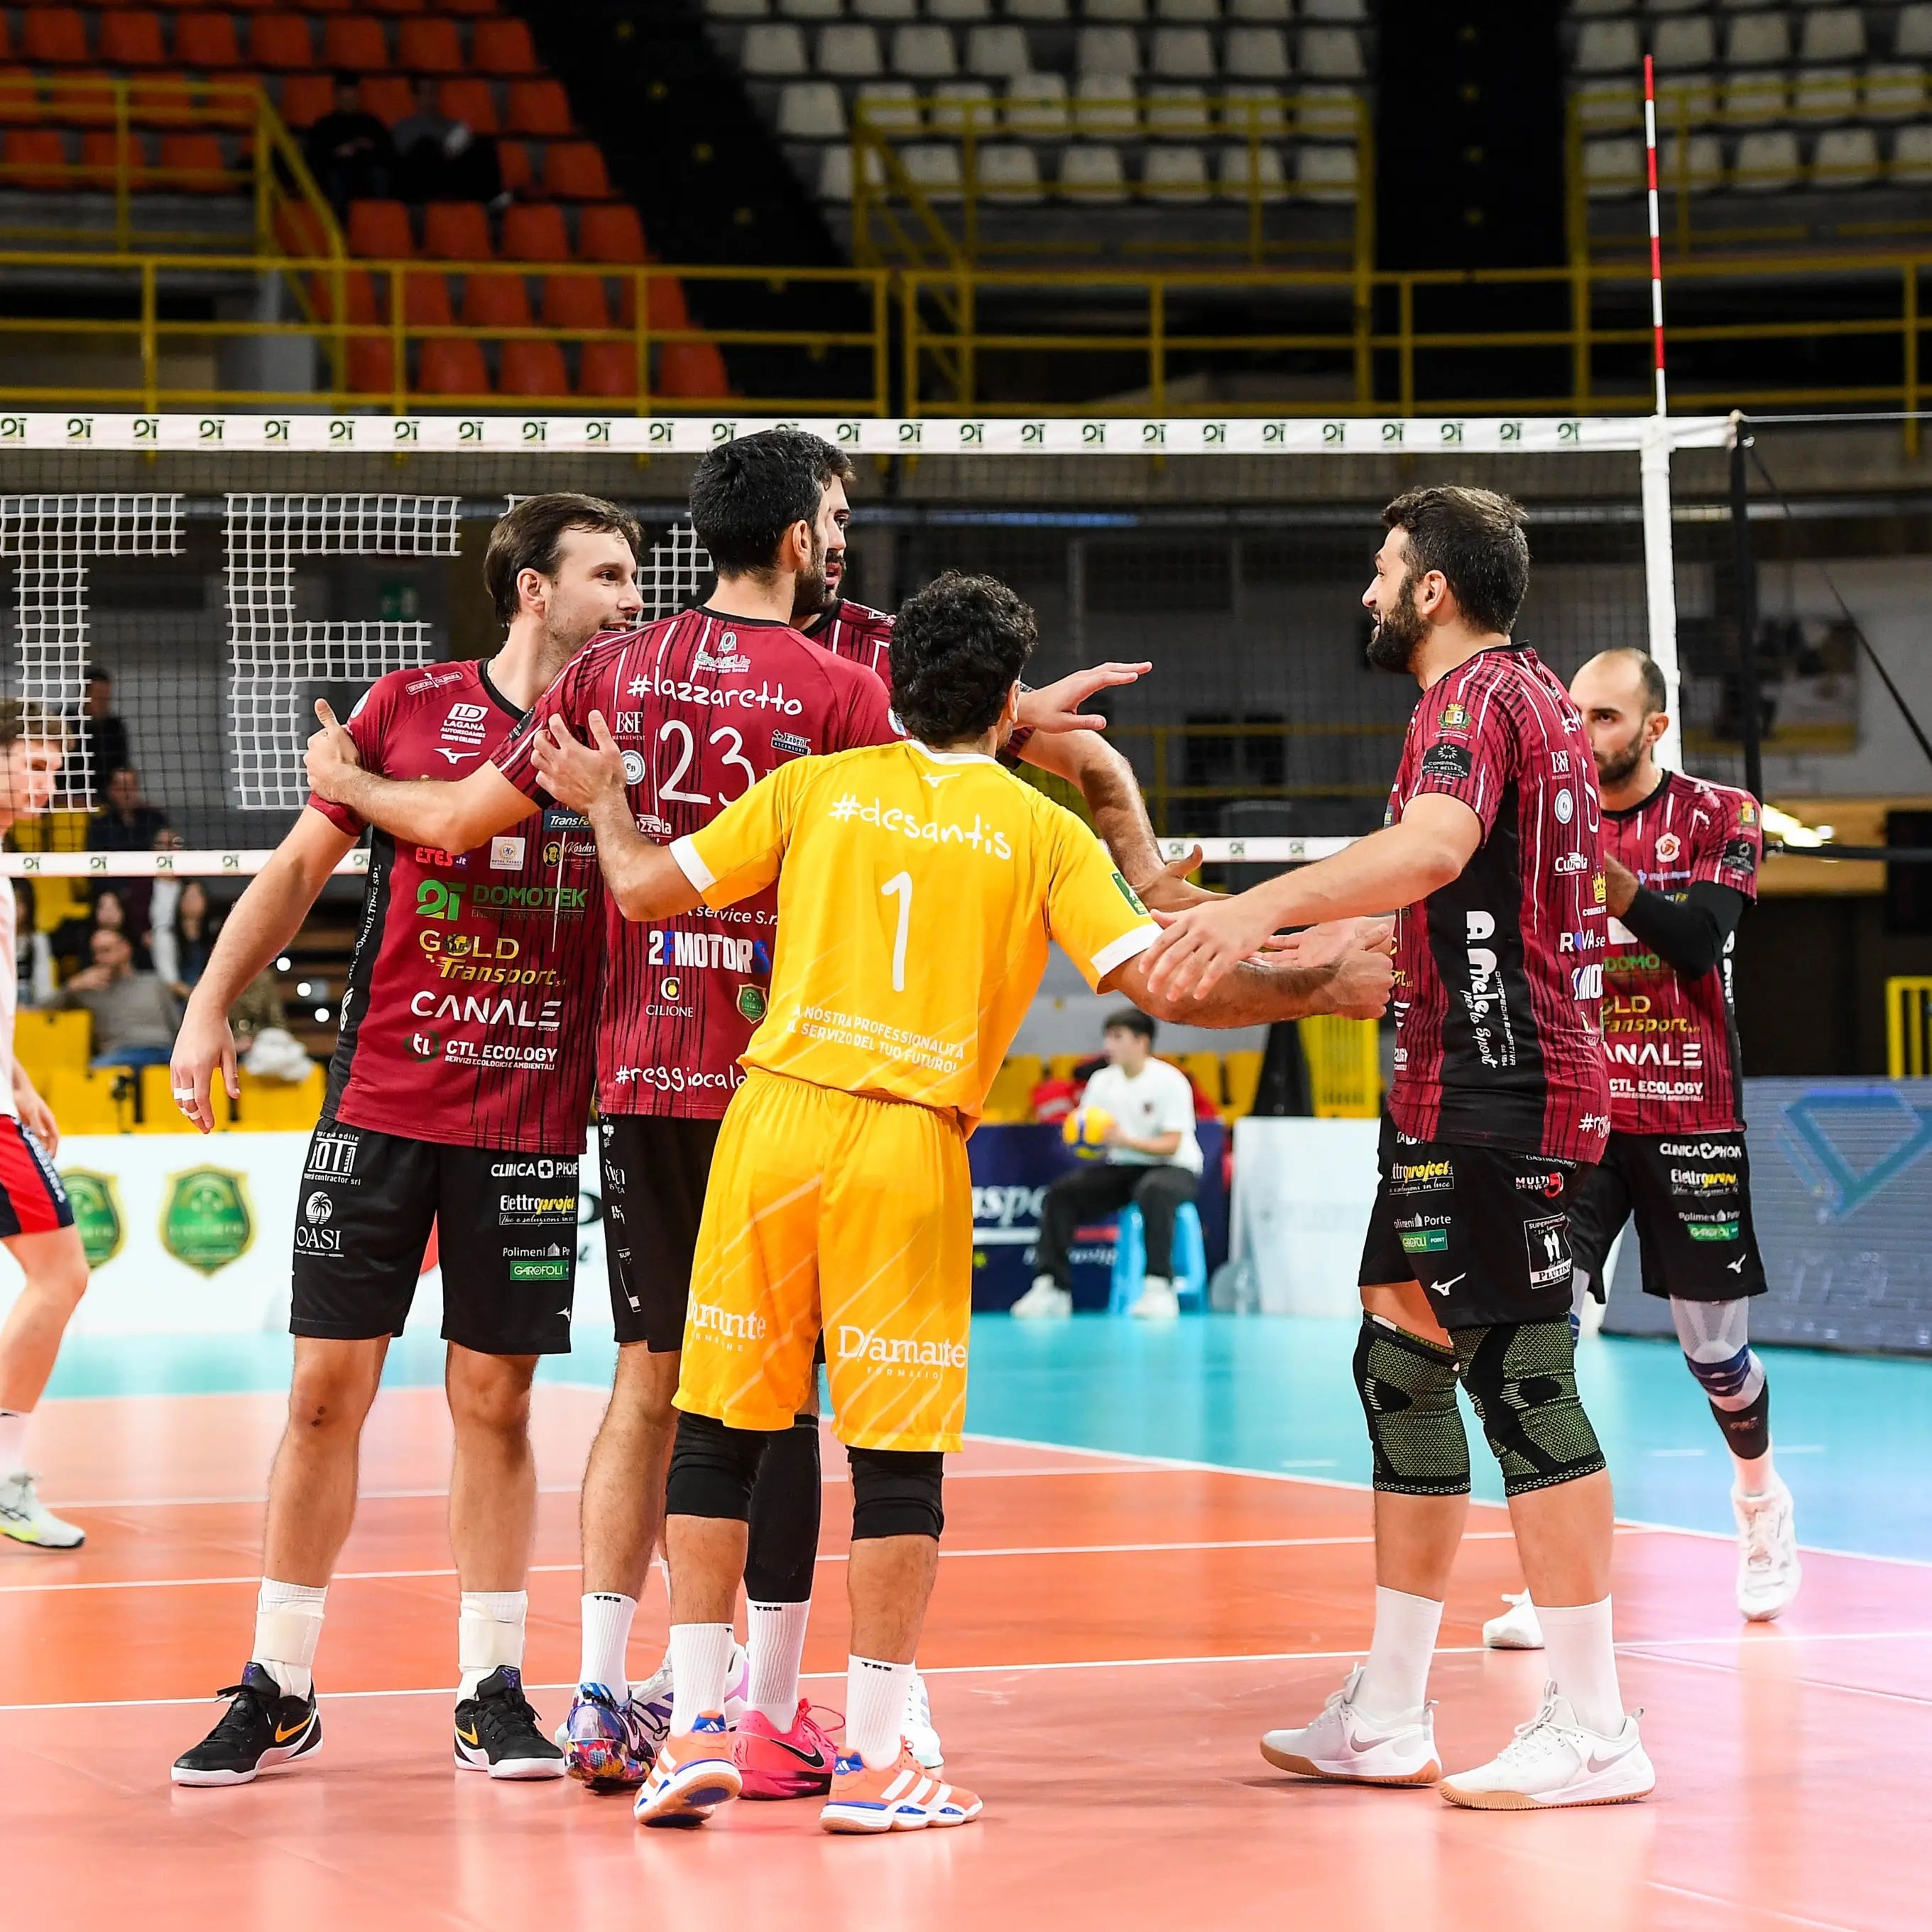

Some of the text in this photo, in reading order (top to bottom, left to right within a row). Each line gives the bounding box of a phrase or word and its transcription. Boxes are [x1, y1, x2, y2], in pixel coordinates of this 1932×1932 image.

[626, 665, 802, 716] #lazzaretto
[659, 719, 755, 805] 23
[829, 792, 1010, 860] #desantis
[473, 885, 588, 907] DOMOTEK
[880, 871, 912, 992] 1
[419, 930, 519, 959] GOLD
[436, 957, 557, 986] Transport
[1604, 954, 1660, 971] DOMO
[410, 990, 562, 1027] CANALE
[645, 1005, 693, 1017] CILIONE
[804, 1005, 851, 1028] NOSTRA
[446, 1040, 479, 1057] CTL
[482, 1045, 557, 1062] ECOLOGY
[853, 1034, 875, 1051] DEL
[880, 1041, 902, 1058] TUO
[444, 1055, 471, 1065] SERVIZI
[1610, 1079, 1704, 1095] CTL ECOLOGY
[315, 1174, 349, 1184] contractor
[1515, 1176, 1549, 1184] MULTI
[1394, 1216, 1451, 1228] olimeni Porte
[296, 1226, 341, 1250] OASI
[503, 1246, 546, 1257] Polimeni
[514, 1265, 563, 1276] GAROFOLI
